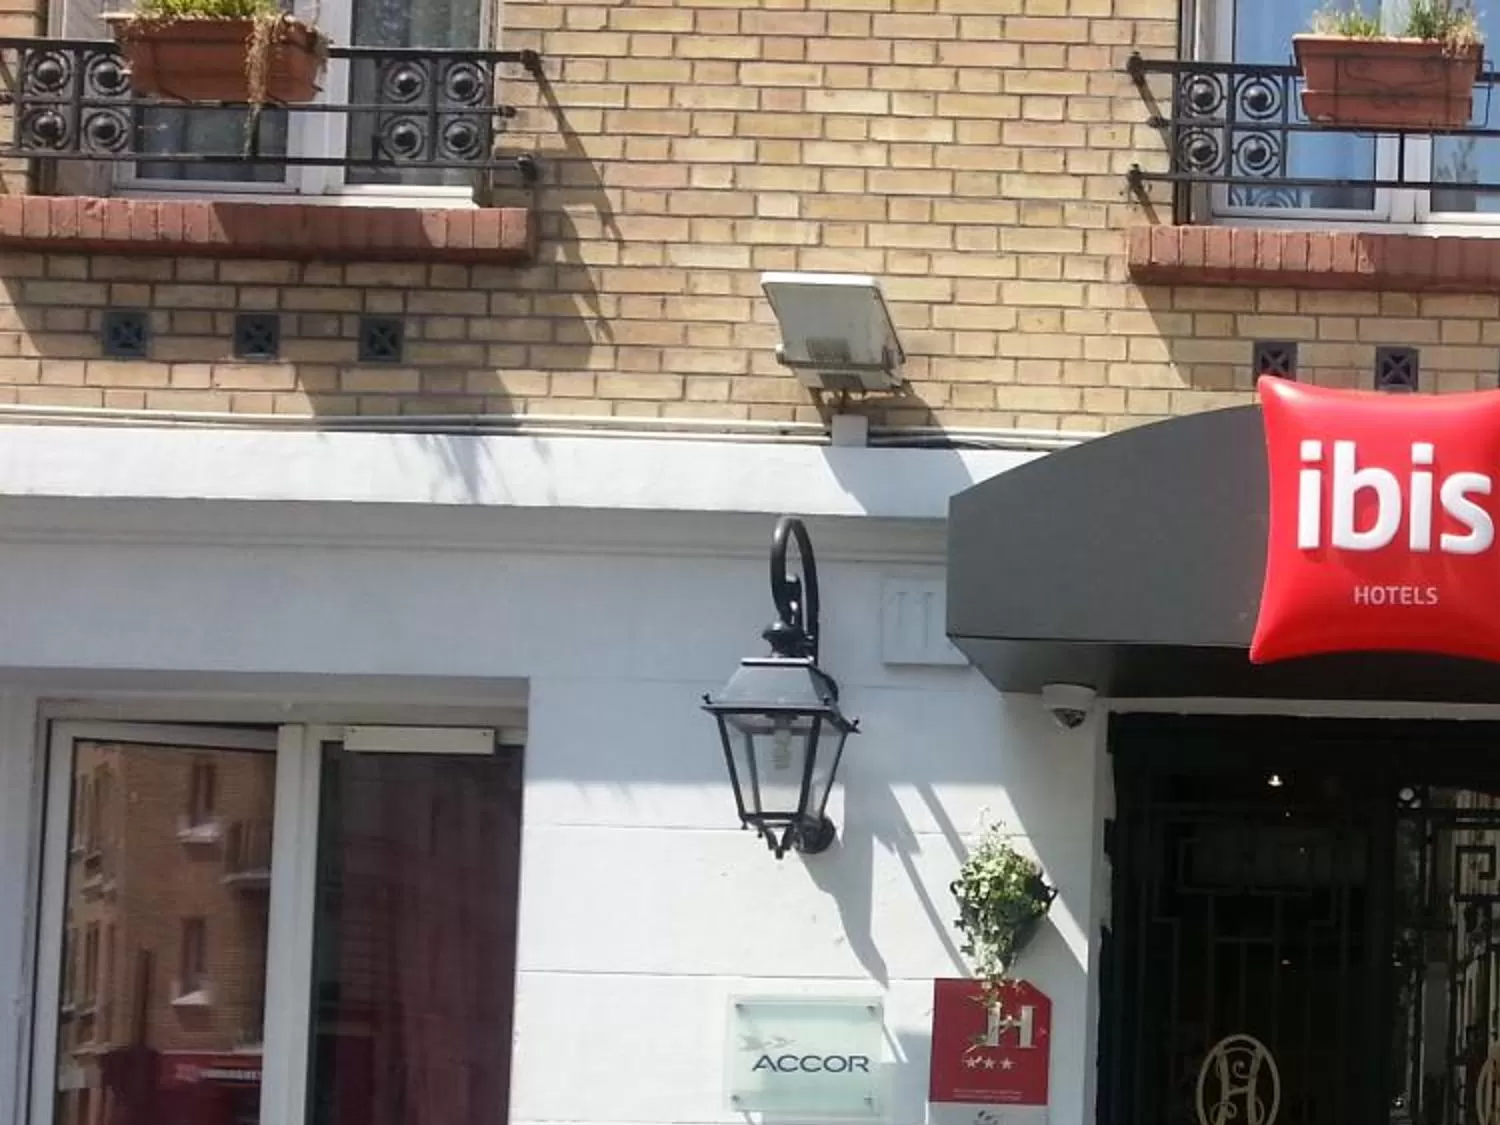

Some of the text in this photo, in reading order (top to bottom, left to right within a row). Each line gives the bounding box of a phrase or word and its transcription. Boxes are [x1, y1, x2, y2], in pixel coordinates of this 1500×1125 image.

[1297, 440, 1495, 554] ibis
[1353, 585, 1438, 606] HOTELS
[981, 1004, 1037, 1049] H
[751, 1055, 870, 1073] ACCOR
